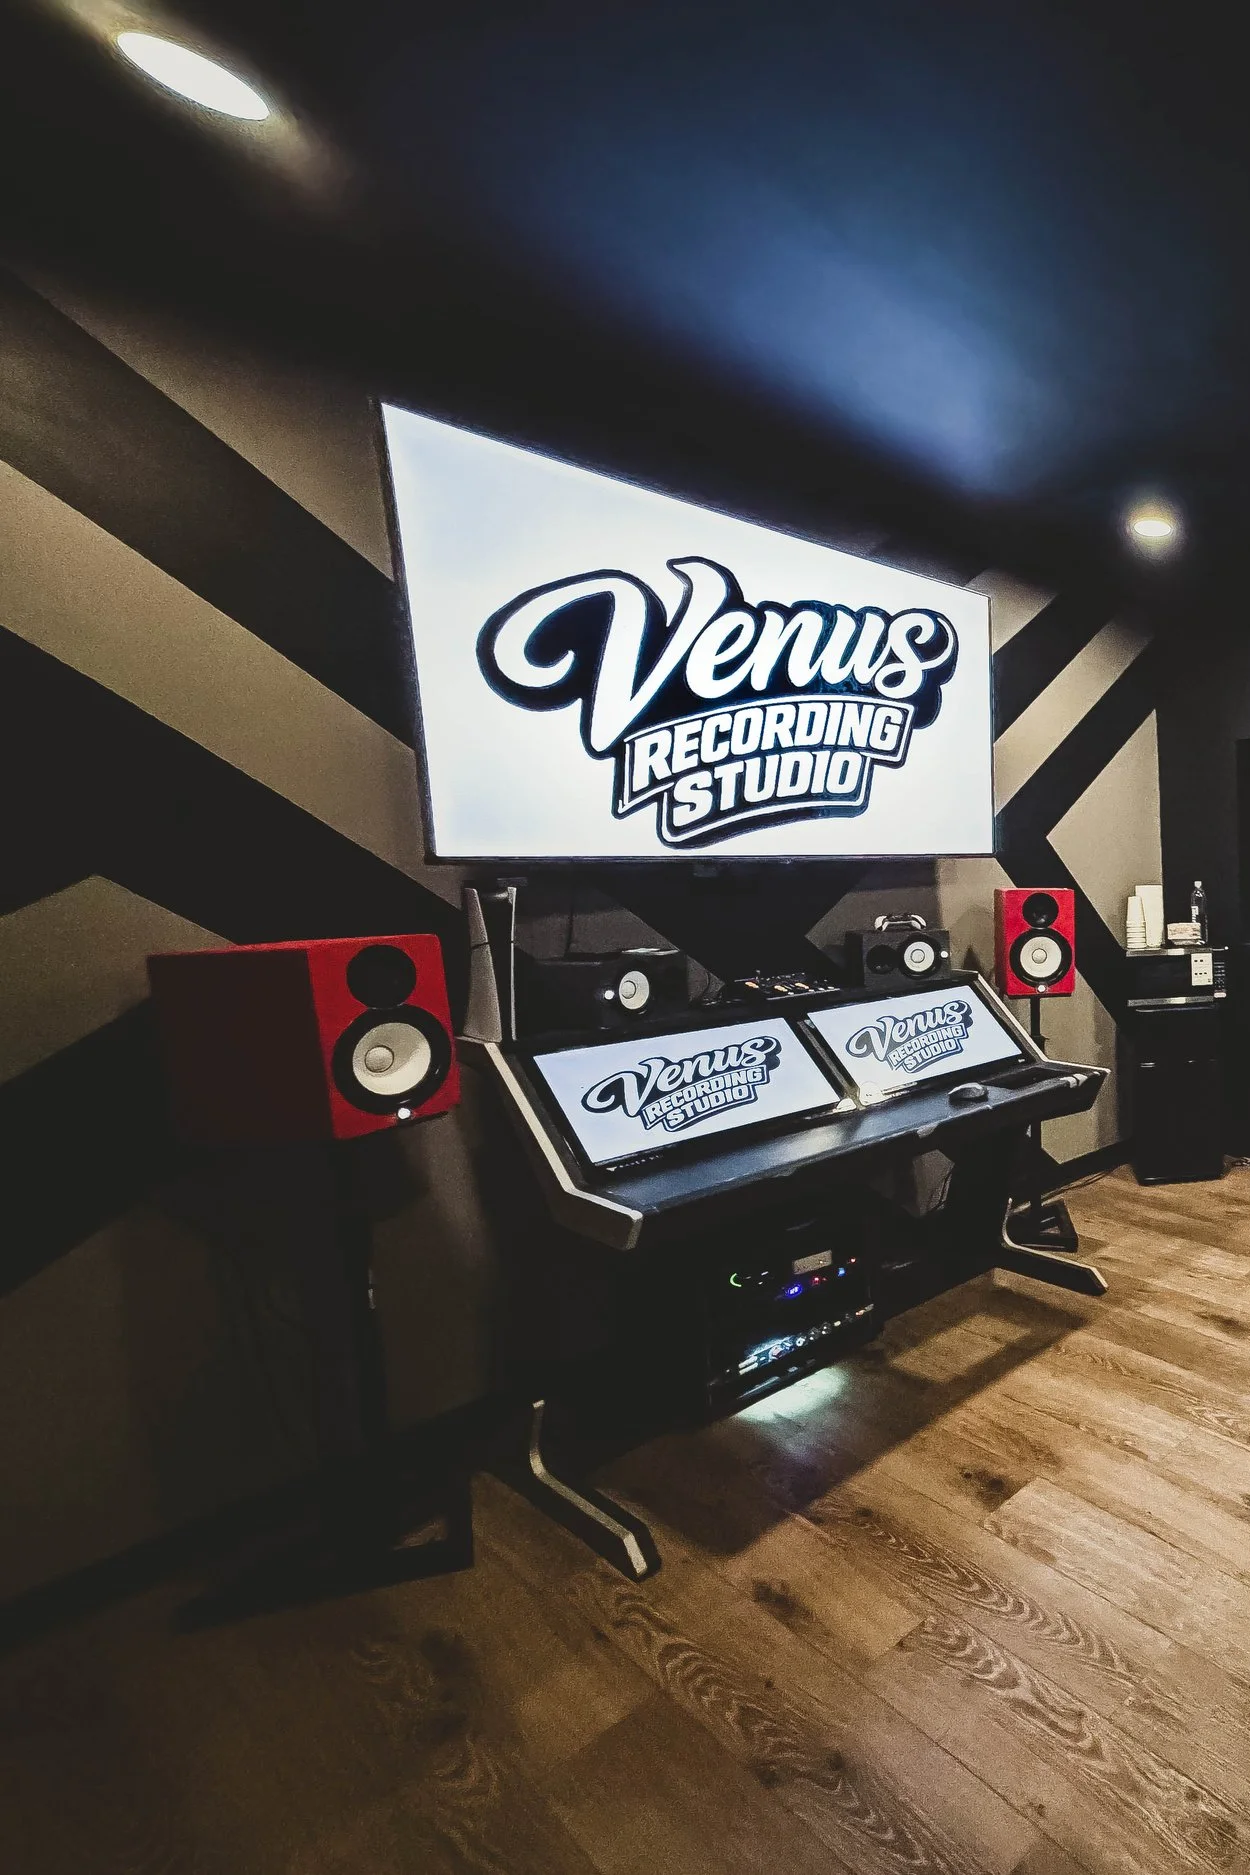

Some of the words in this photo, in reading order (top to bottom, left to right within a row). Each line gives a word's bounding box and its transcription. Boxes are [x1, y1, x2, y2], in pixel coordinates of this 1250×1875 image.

[476, 555, 958, 757] Venus
[631, 700, 904, 794] RECORDING
[671, 749, 864, 829] STUDIO
[844, 1000, 973, 1062] Venus
[890, 1026, 965, 1064] RECORDING
[905, 1038, 955, 1069] STUDIO
[581, 1036, 782, 1118] Venus
[645, 1066, 765, 1124] RECORDING
[666, 1084, 750, 1126] STUDIO
